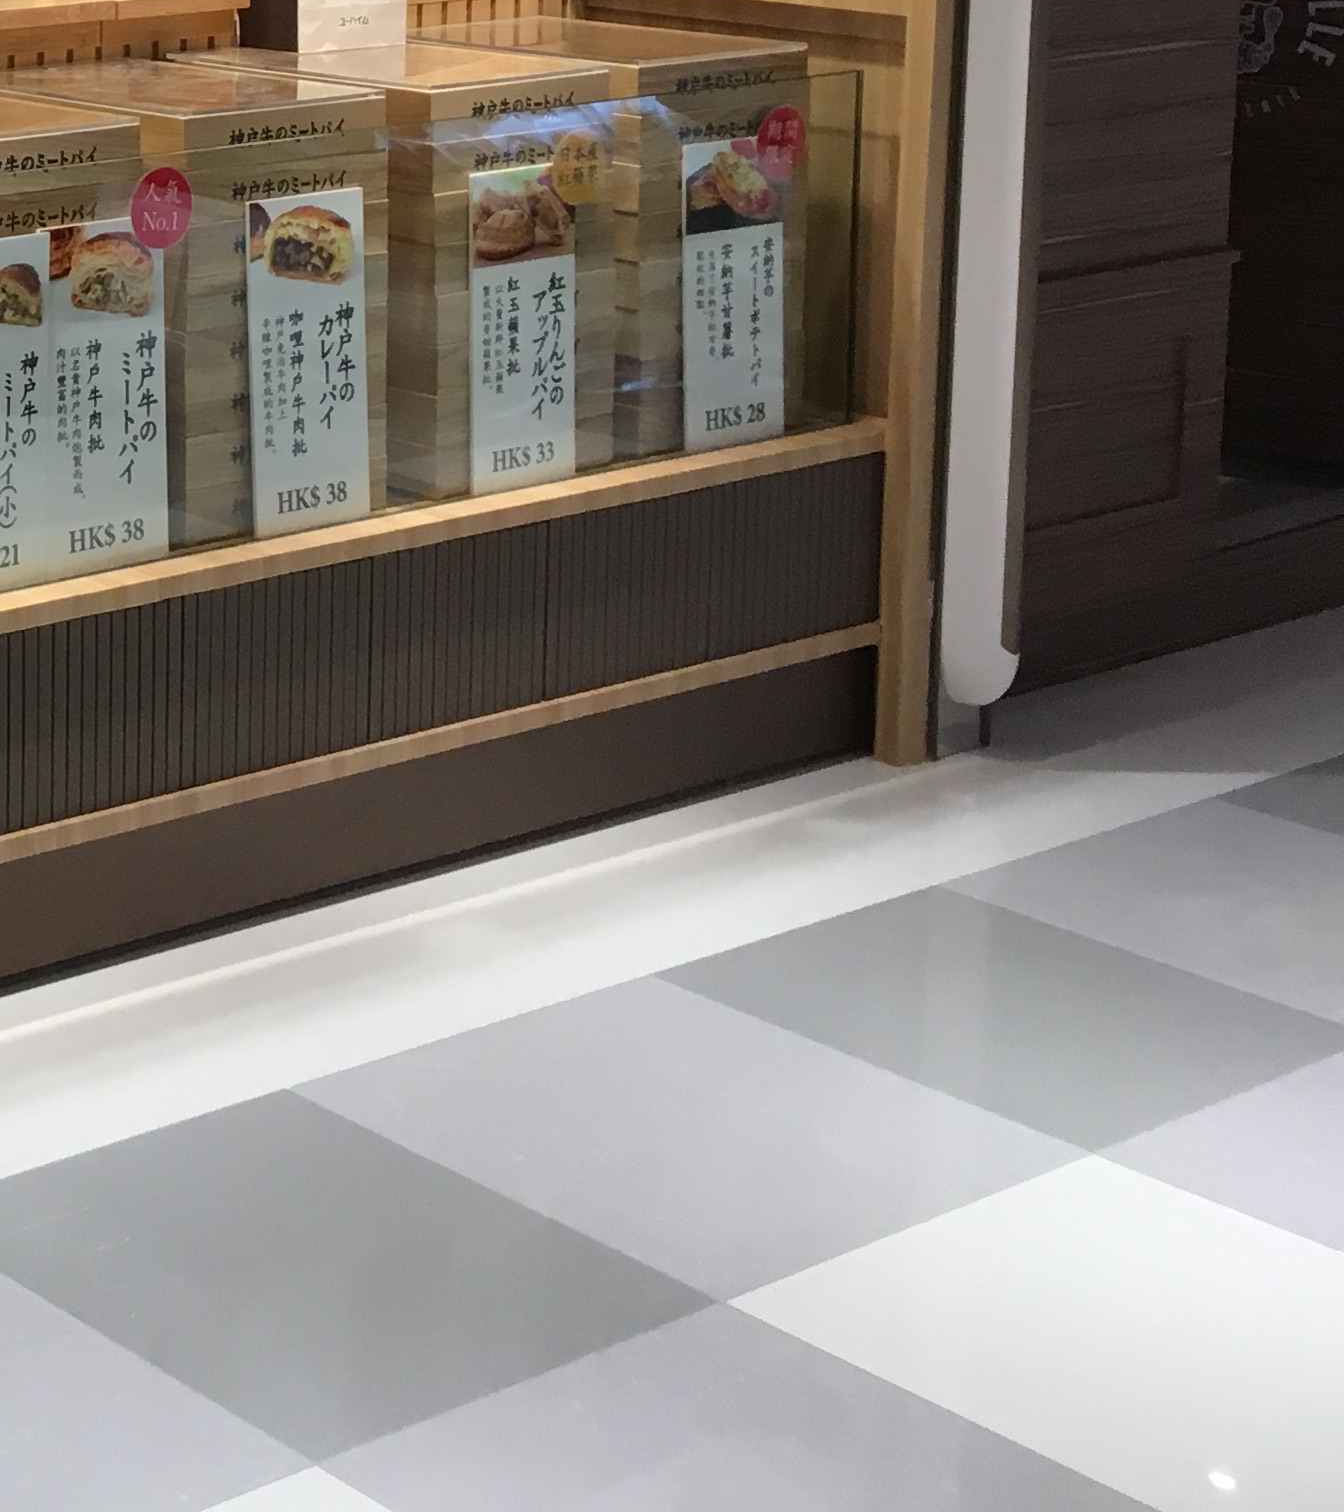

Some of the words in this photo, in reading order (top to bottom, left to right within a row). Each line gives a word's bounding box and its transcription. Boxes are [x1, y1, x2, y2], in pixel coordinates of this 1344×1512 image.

[143, 179, 182, 204] 人氣
[142, 210, 179, 234] No.1
[335, 300, 356, 403] 神戸牛の
[531, 290, 549, 420] アップルパイ
[135, 329, 158, 442] 神戸牛の
[318, 314, 337, 430] カレーパイ
[20, 350, 39, 446] 神戸牛の
[705, 405, 743, 431] HK$
[747, 402, 766, 424] 28
[118, 352, 138, 485] ミートパイ
[492, 446, 531, 473] HK$
[536, 441, 555, 464] 33
[276, 486, 321, 516] HK$
[326, 480, 347, 504] 38
[69, 523, 116, 555] HK$
[121, 518, 145, 542] 38
[0, 544, 20, 568] 21
